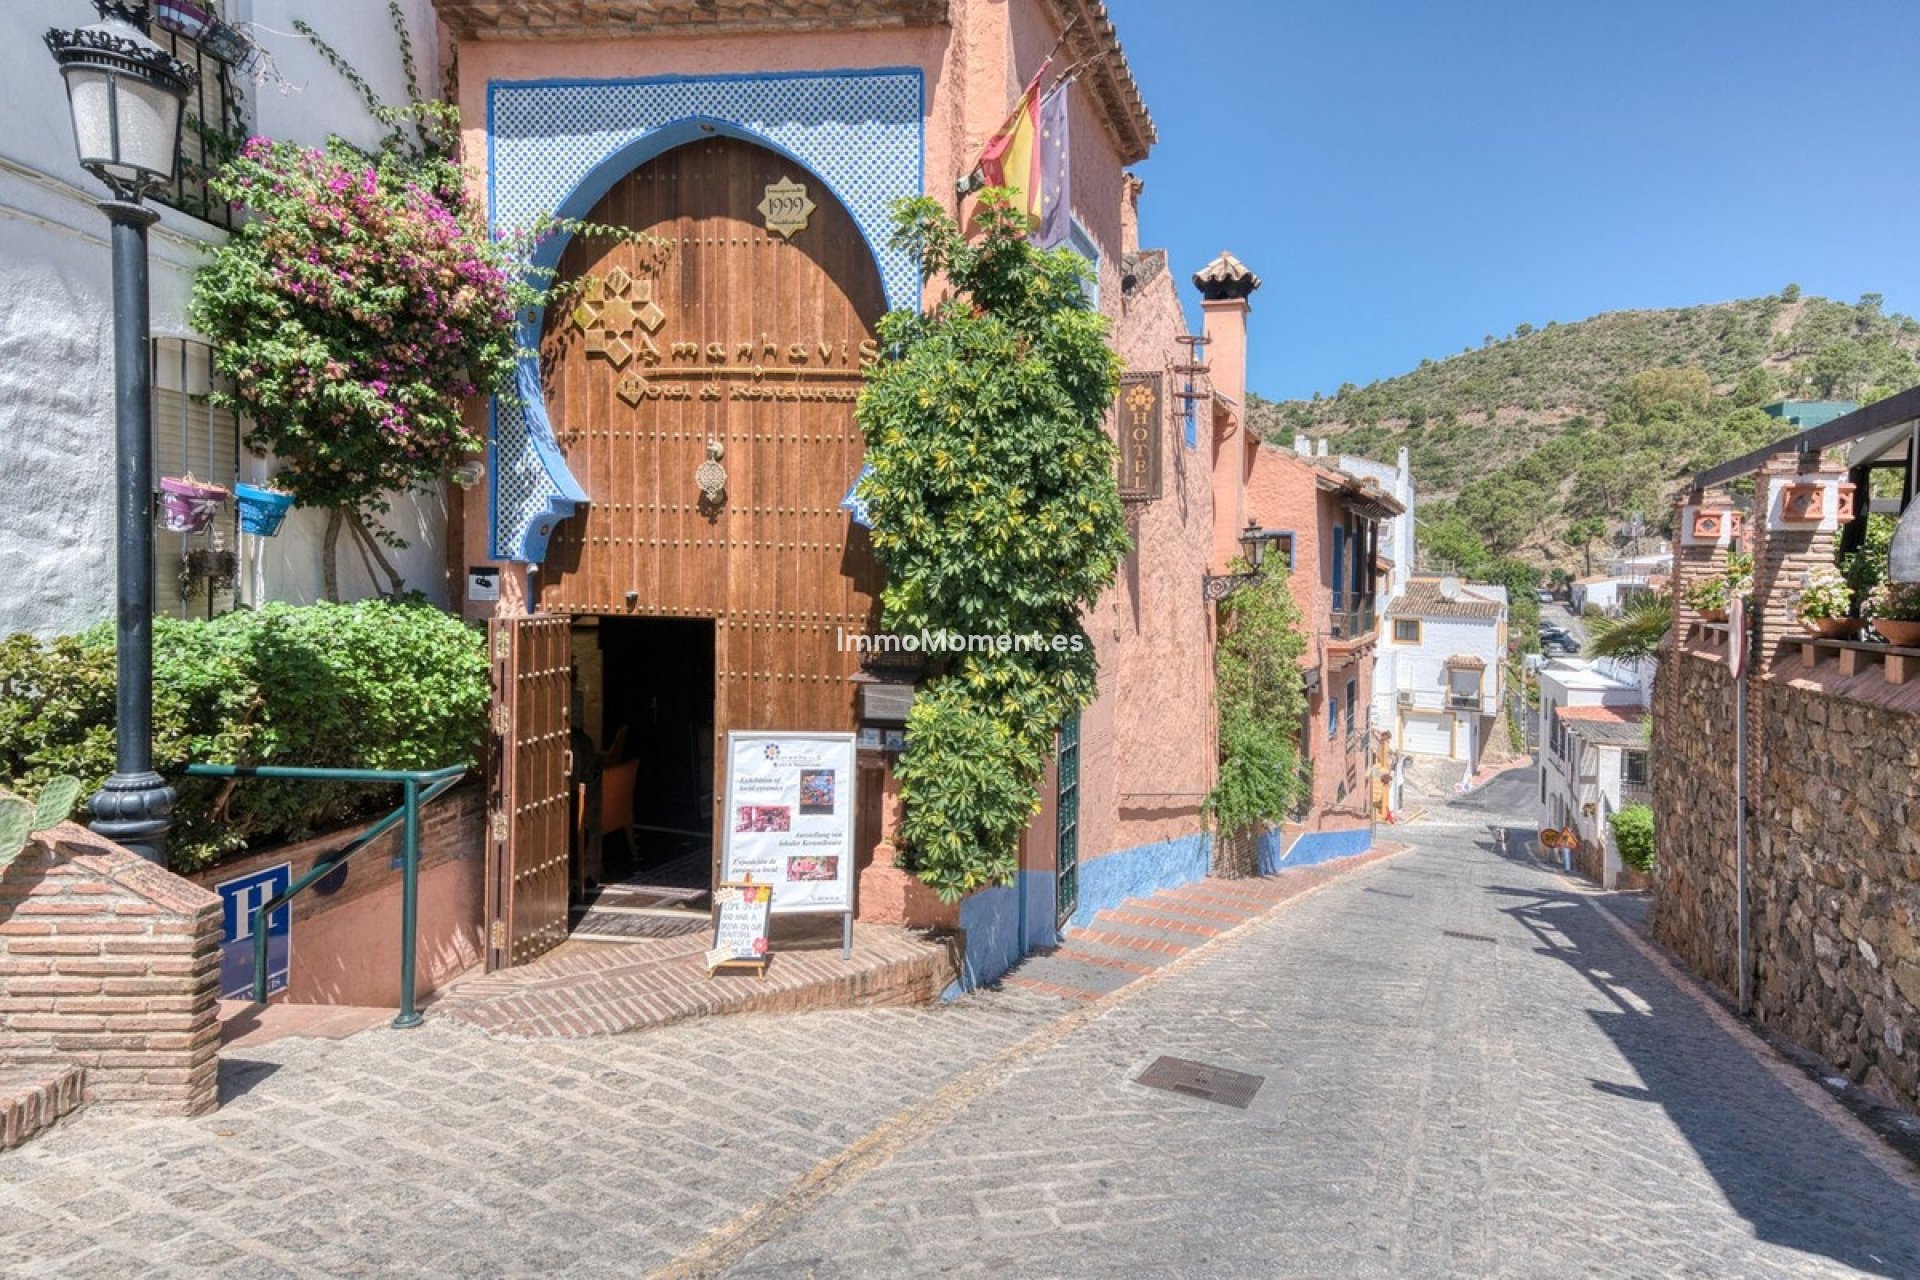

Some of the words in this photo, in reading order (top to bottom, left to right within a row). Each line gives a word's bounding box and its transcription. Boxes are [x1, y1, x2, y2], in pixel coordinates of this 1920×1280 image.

[769, 197, 804, 216] 1999
[699, 383, 720, 397] &
[729, 383, 858, 398] Restauran
[1132, 412, 1148, 489] HOTEL
[231, 877, 278, 944] H
